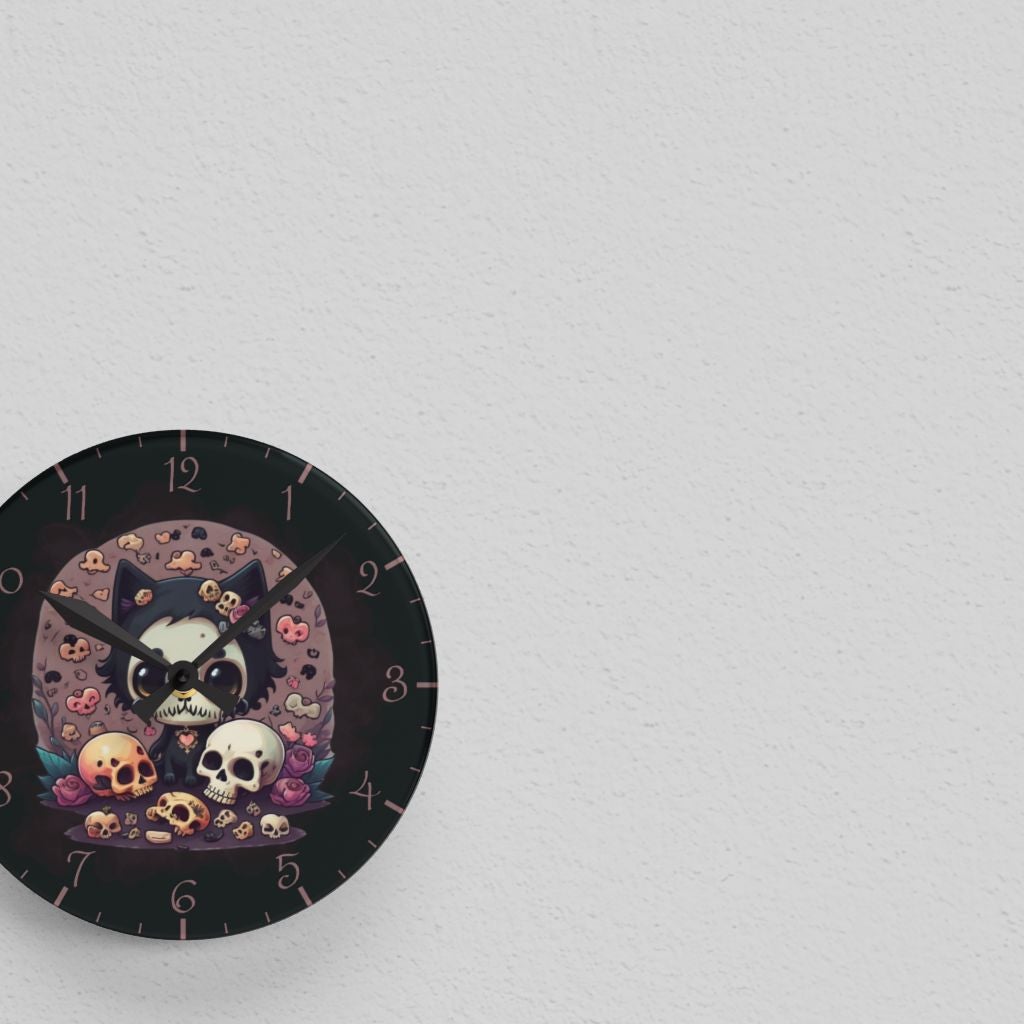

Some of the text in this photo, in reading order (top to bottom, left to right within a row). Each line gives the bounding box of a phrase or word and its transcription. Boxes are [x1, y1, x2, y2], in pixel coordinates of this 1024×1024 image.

[162, 456, 203, 494] 12
[59, 484, 88, 521] 11
[281, 484, 294, 521] 1
[356, 562, 380, 597] 2
[382, 665, 409, 703] 3
[348, 770, 382, 809] 4
[66, 850, 96, 887] 7
[275, 851, 301, 890] 5
[170, 879, 198, 914] 6
